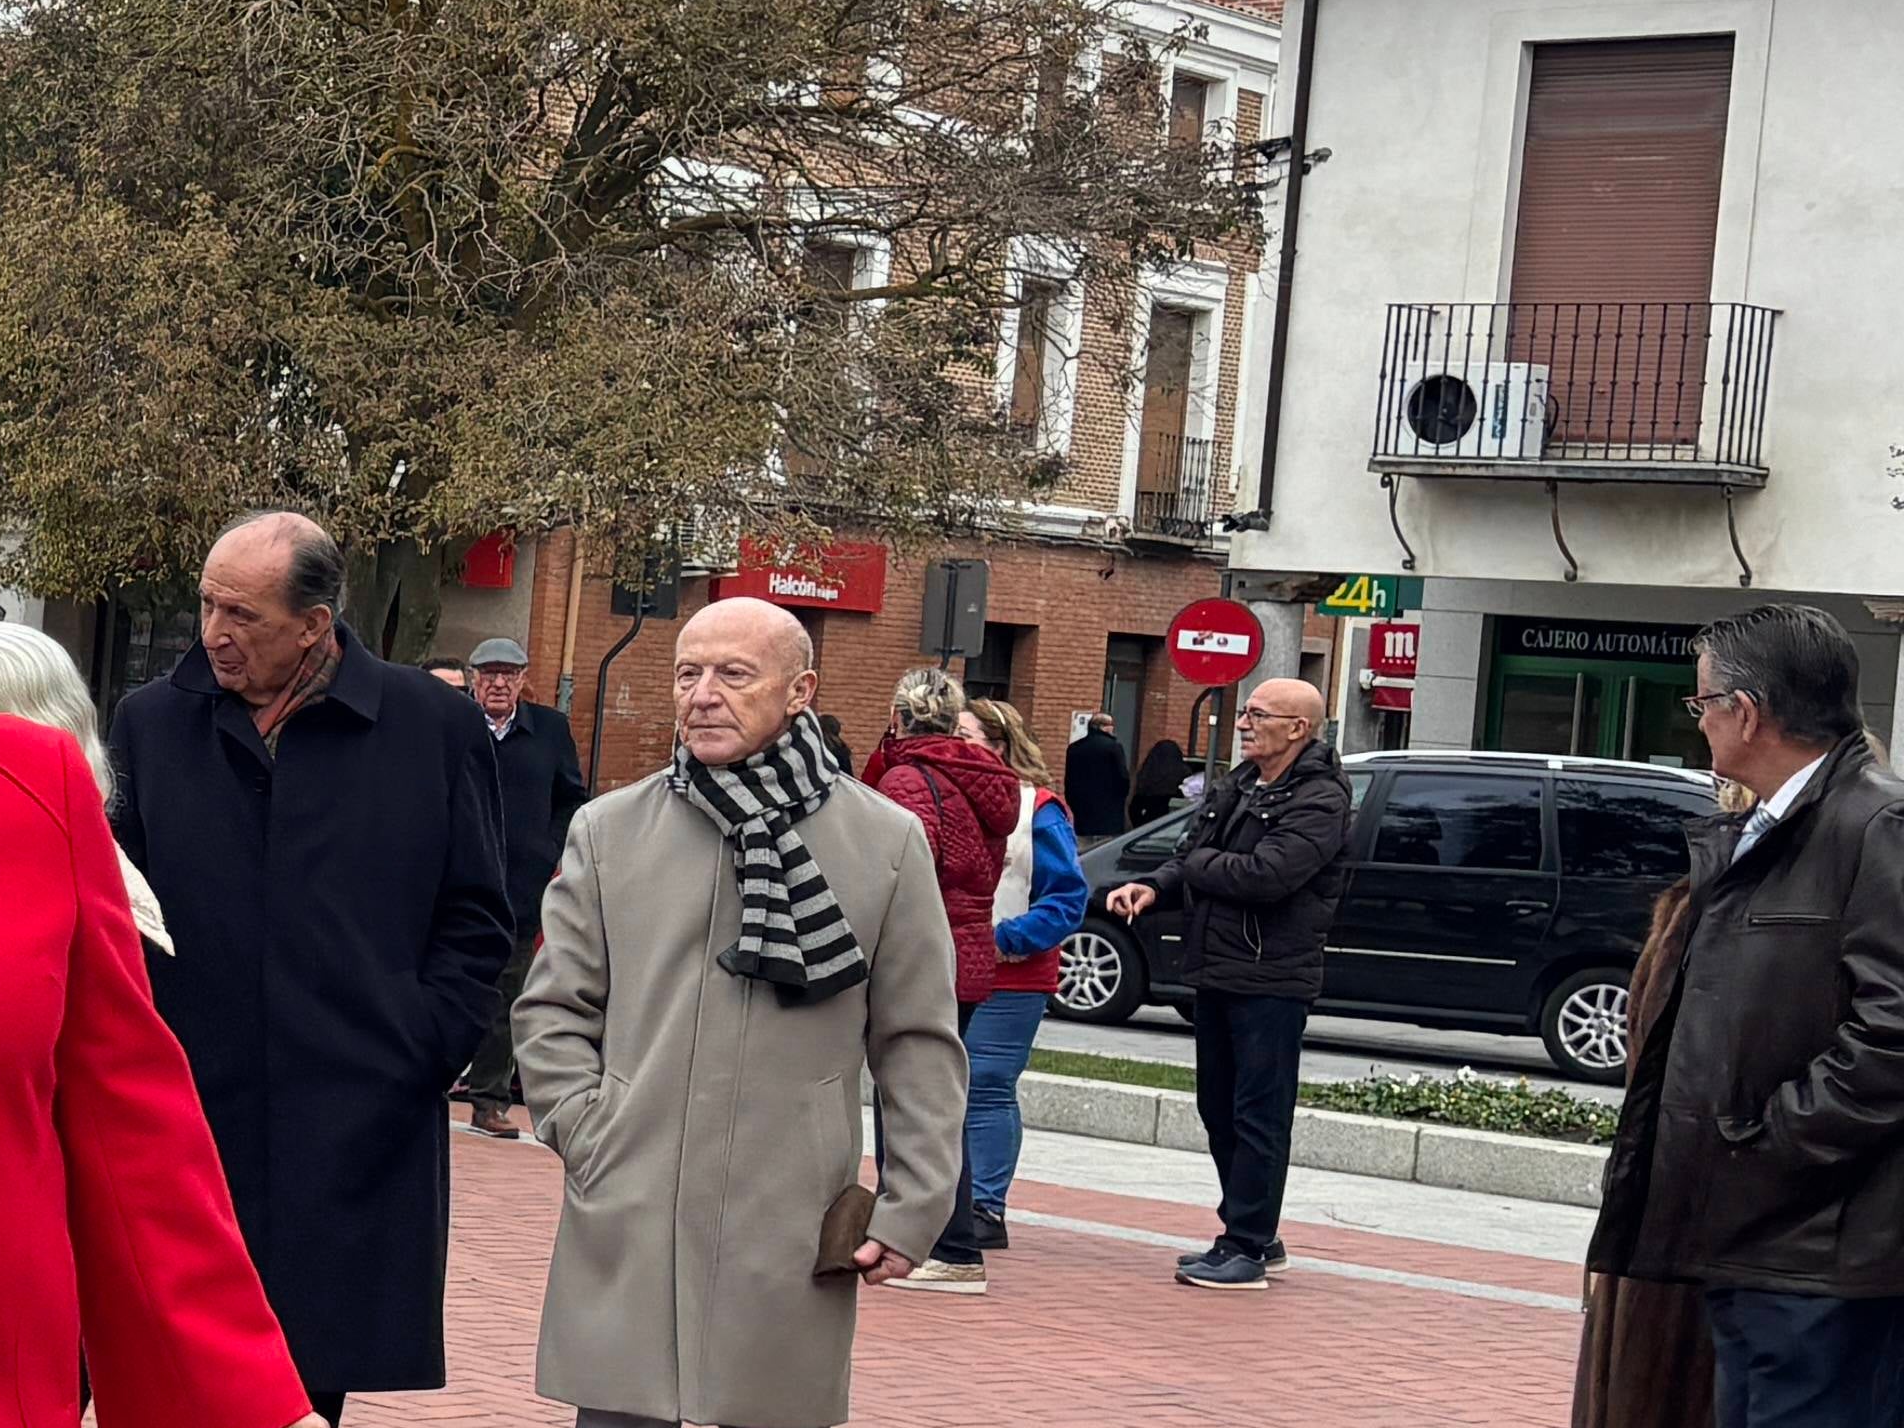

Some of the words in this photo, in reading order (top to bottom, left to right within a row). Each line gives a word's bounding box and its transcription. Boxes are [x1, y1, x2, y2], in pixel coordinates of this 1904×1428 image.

[769, 573, 816, 597] Halcón
[1325, 575, 1386, 613] 24h
[1593, 631, 1698, 655] AUTOMÁTIC
